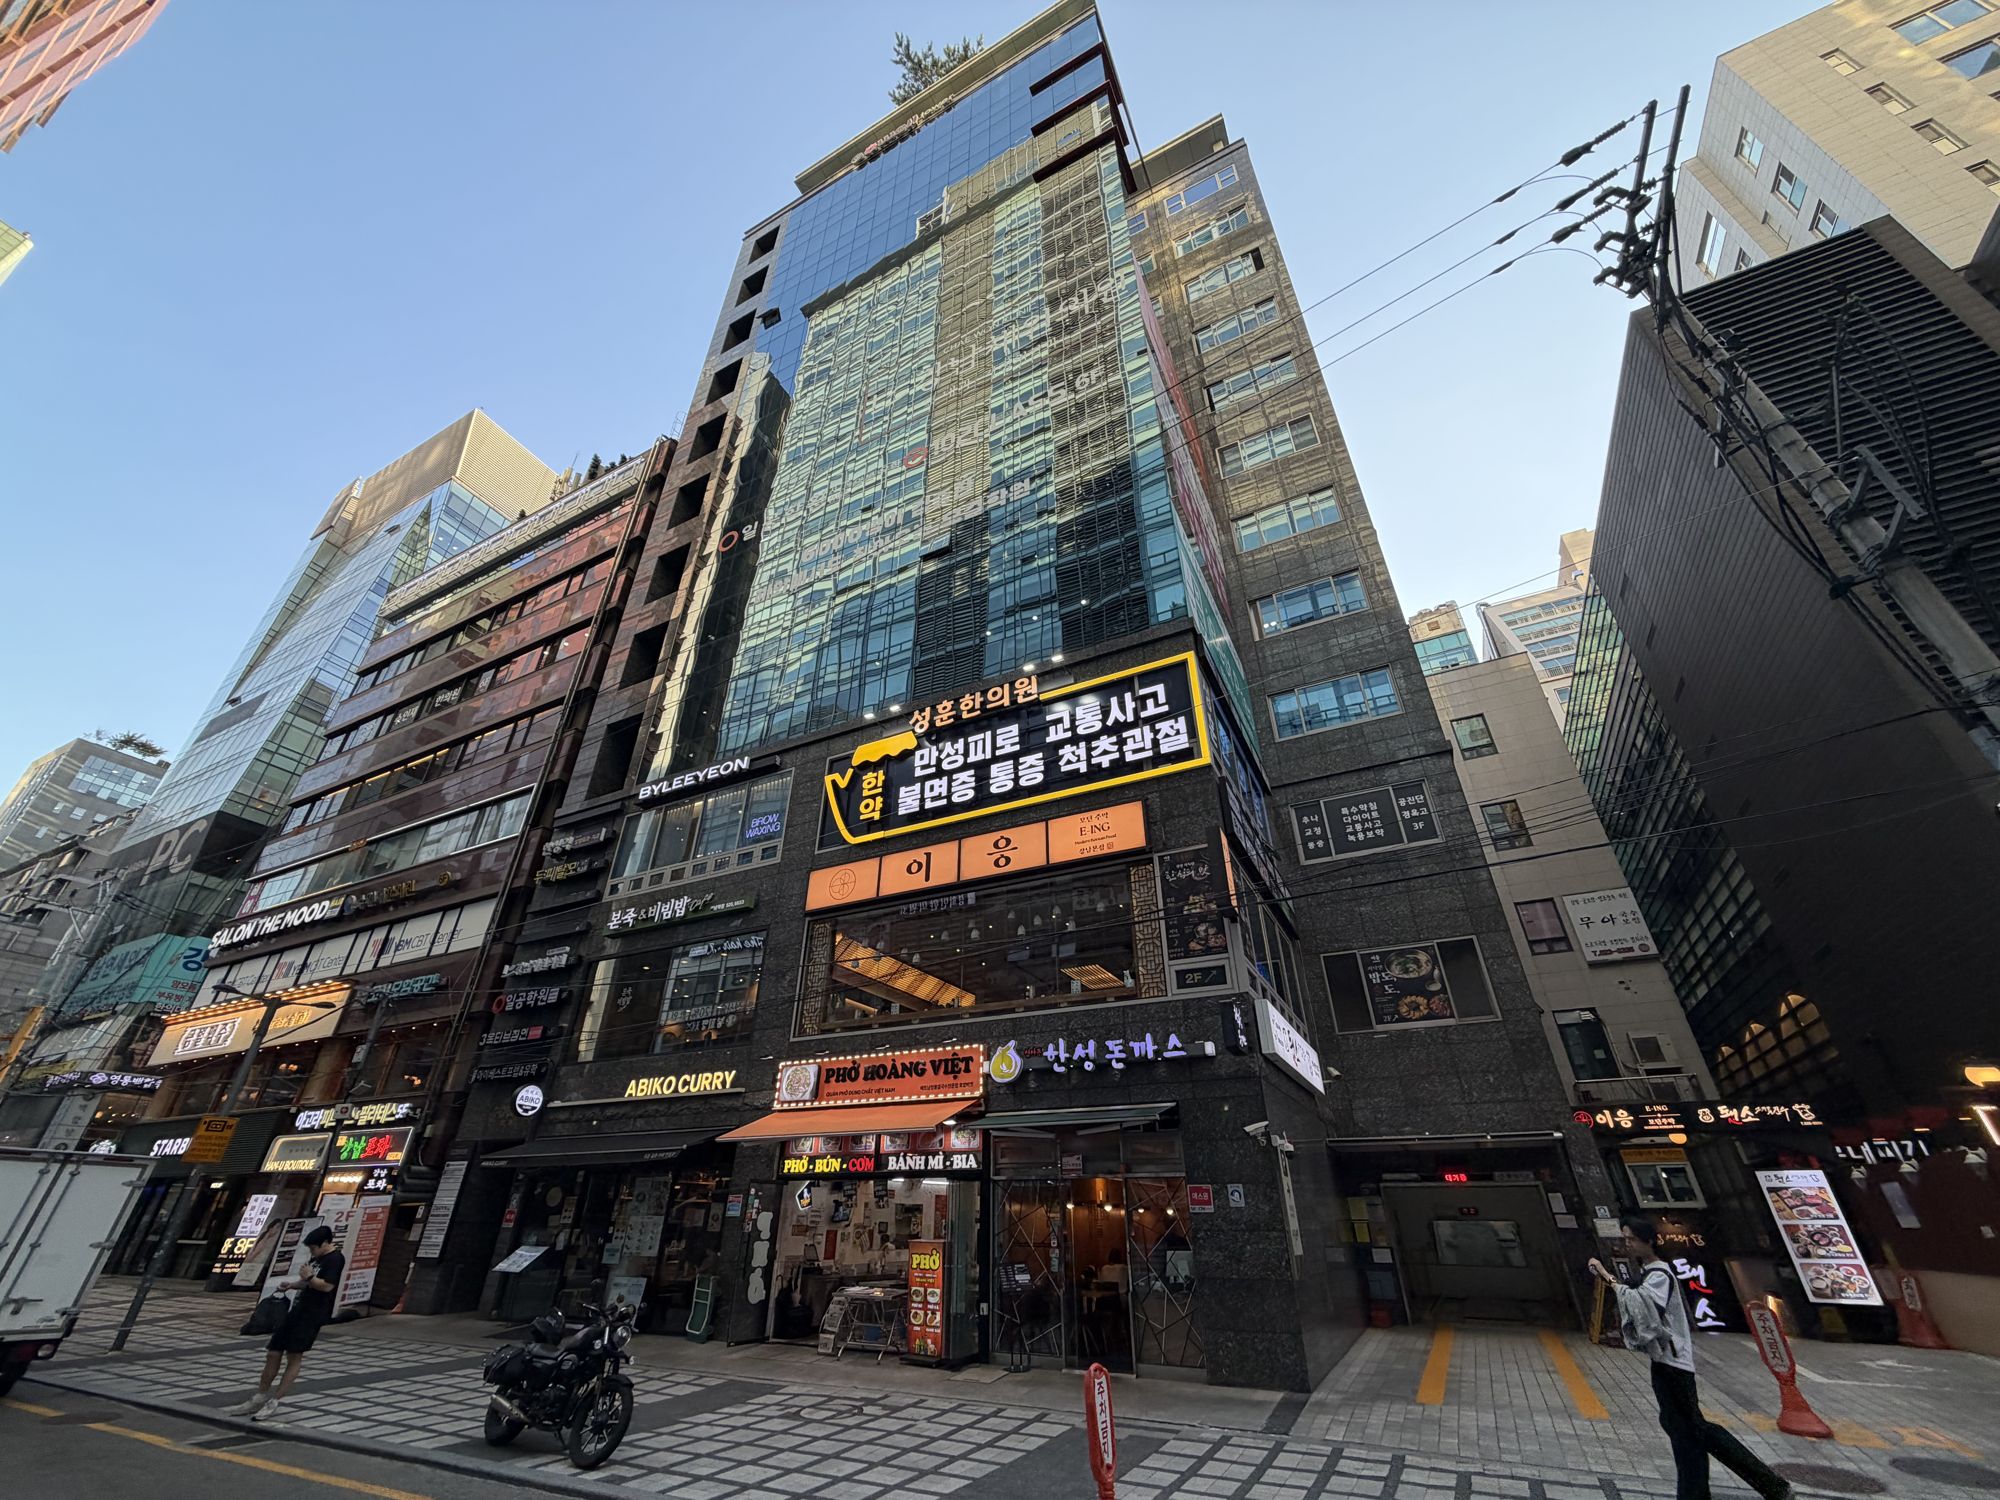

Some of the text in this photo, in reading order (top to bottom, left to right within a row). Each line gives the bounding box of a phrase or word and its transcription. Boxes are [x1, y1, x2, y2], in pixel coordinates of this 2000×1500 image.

[908, 674, 1039, 734] 성훈한의원
[913, 683, 1170, 777] 만성피로 교통사고
[897, 715, 1190, 816] 불면증 통증 척추관절
[637, 755, 750, 801] BYLEEYEON
[1397, 793, 1426, 807] 공진단
[1340, 803, 1378, 817] 특수약침
[1342, 811, 1381, 824] 다이어트
[750, 812, 780, 828] BROW
[1301, 814, 1320, 825] 추나
[1344, 819, 1384, 833] 교통사고
[1413, 820, 1426, 831] 3F
[745, 821, 781, 839] WAXING
[1079, 821, 1111, 837] E-ING
[1304, 825, 1323, 837] 교정
[207, 899, 330, 951] SALON THE MOOD
[1184, 972, 1202, 984] 2F
[863, 1058, 928, 1084] HOÀNG
[929, 1051, 975, 1082] VIỆT
[624, 1069, 738, 1098] ABIKO CURRY
[1645, 1104, 1669, 1113] E-ING
[1596, 1108, 1634, 1130] 이응
[814, 1153, 841, 1173] BÚN
[888, 1152, 926, 1171] BÁNH
[951, 1153, 978, 1169] BIA
[333, 1210, 357, 1223] 2F
[910, 1248, 941, 1271] PHỞ
[1756, 1311, 1785, 1363] 주차금지
[1096, 1381, 1111, 1458] 주차금지
